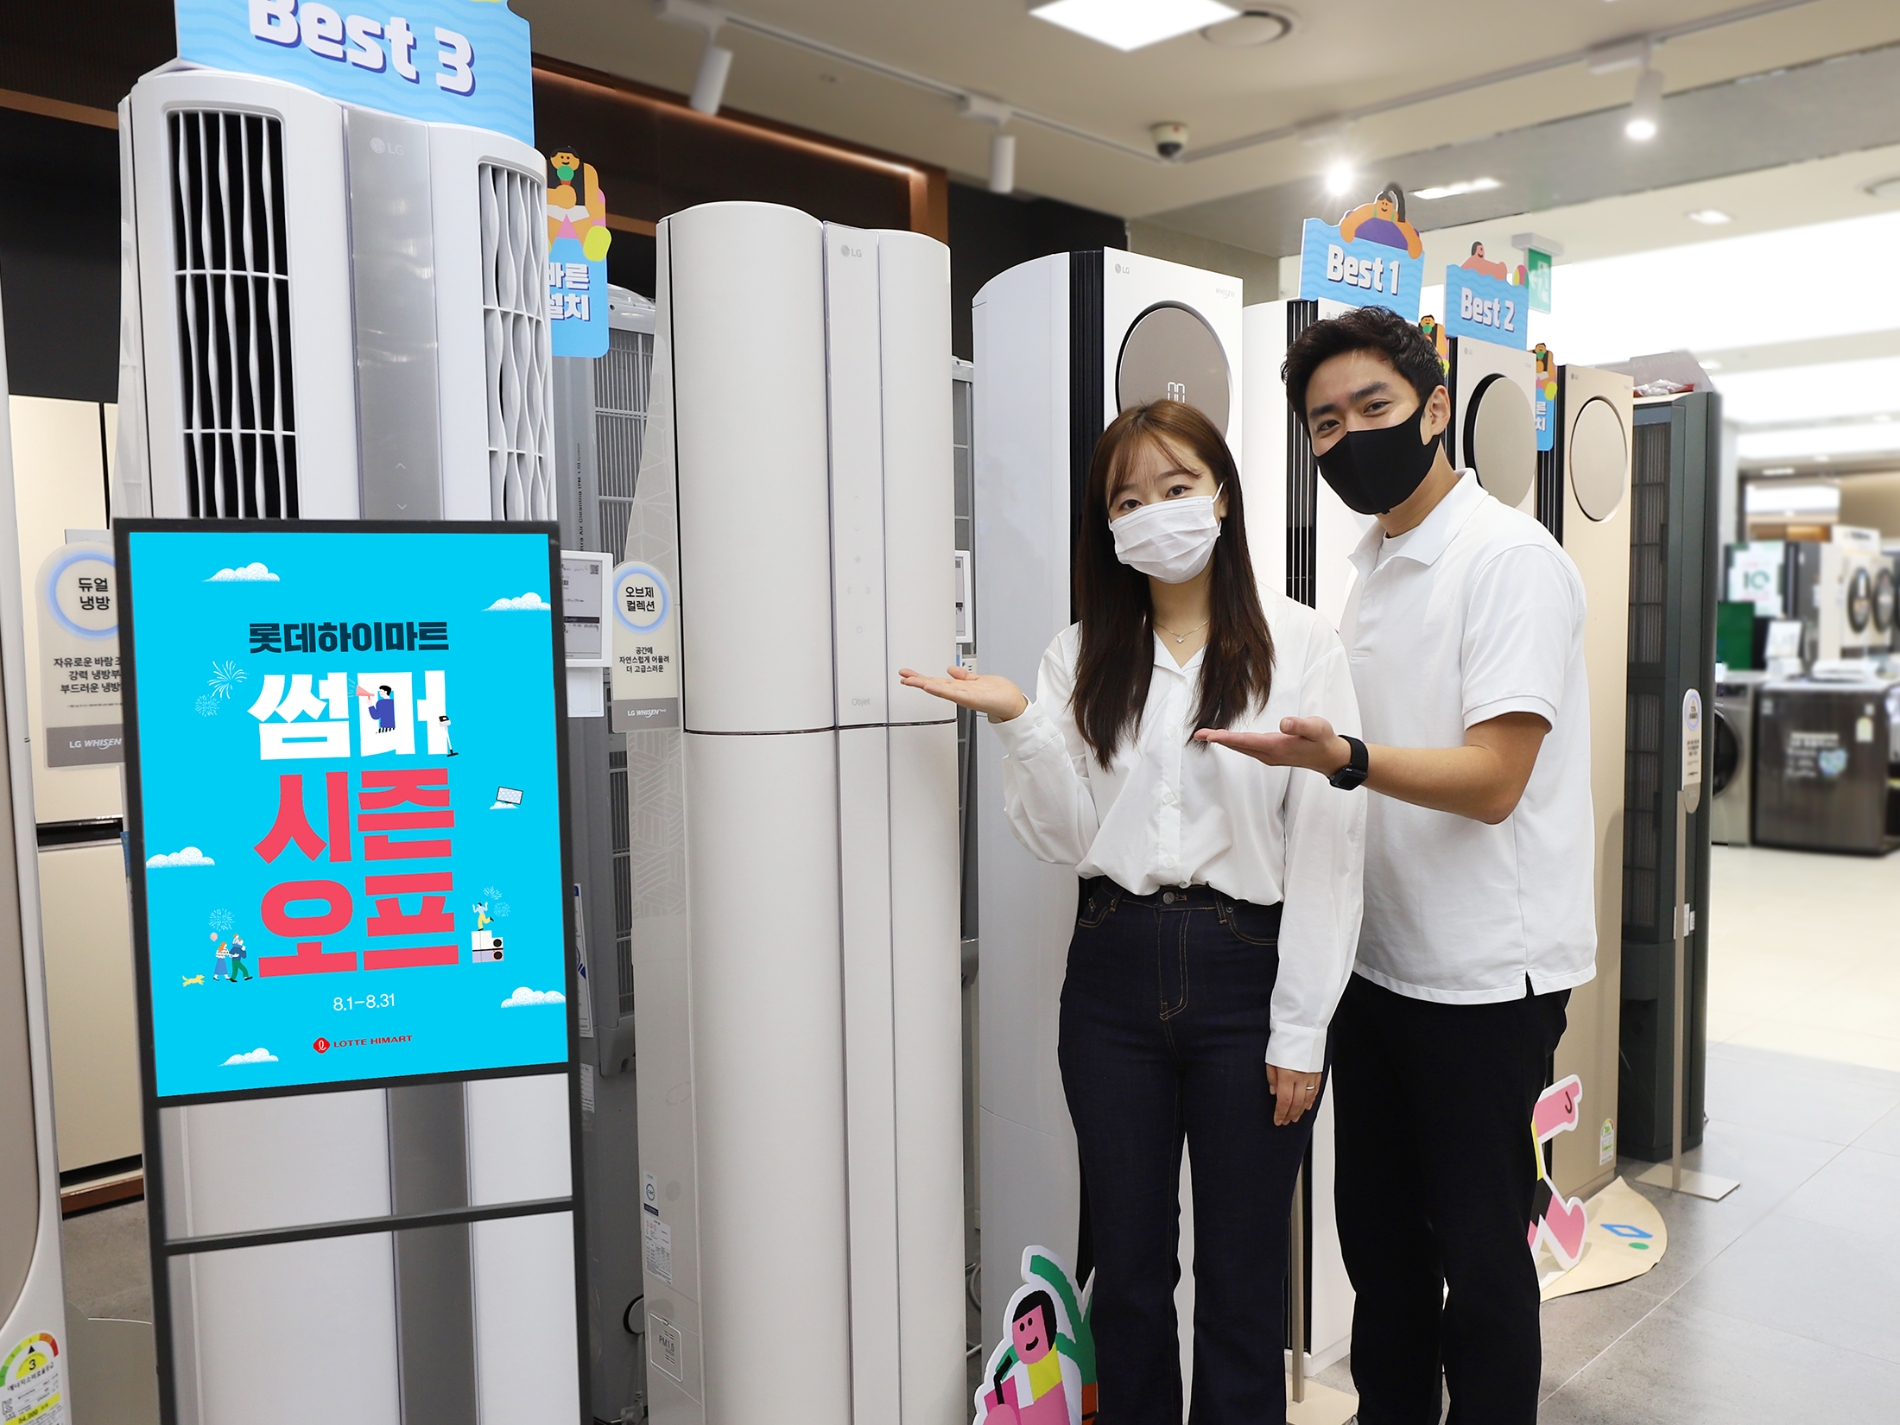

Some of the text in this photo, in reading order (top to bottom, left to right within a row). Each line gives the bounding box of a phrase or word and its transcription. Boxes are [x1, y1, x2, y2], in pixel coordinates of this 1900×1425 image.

[248, 0, 476, 97] Best 3
[387, 142, 405, 156] LG
[851, 247, 863, 258] LG
[1326, 244, 1400, 296] Best 1
[1460, 287, 1515, 333] Best 2
[78, 577, 109, 593] 듀얼
[625, 586, 655, 598] 오브제
[79, 595, 111, 611] 냉방
[626, 600, 656, 612] 컬렉션
[249, 621, 449, 653] 롯데하이마트
[635, 646, 654, 655] 공간에
[53, 657, 93, 668] 자유로운
[94, 656, 113, 667] 바람
[619, 655, 670, 664] 자연스럽게 어울려
[626, 664, 664, 673] 더 고급스러운
[69, 670, 89, 681] 강력
[60, 681, 122, 694] 부드러운 냉방
[247, 670, 450, 760] 썸머
[628, 709, 636, 717] LG
[636, 708, 660, 719] WHISEN
[69, 737, 122, 750] LG WHISEN
[253, 768, 455, 864] 시즌
[258, 871, 459, 978] 오프
[333, 1034, 413, 1049] LOTTE HIMART
[28, 1358, 37, 1371] 3
